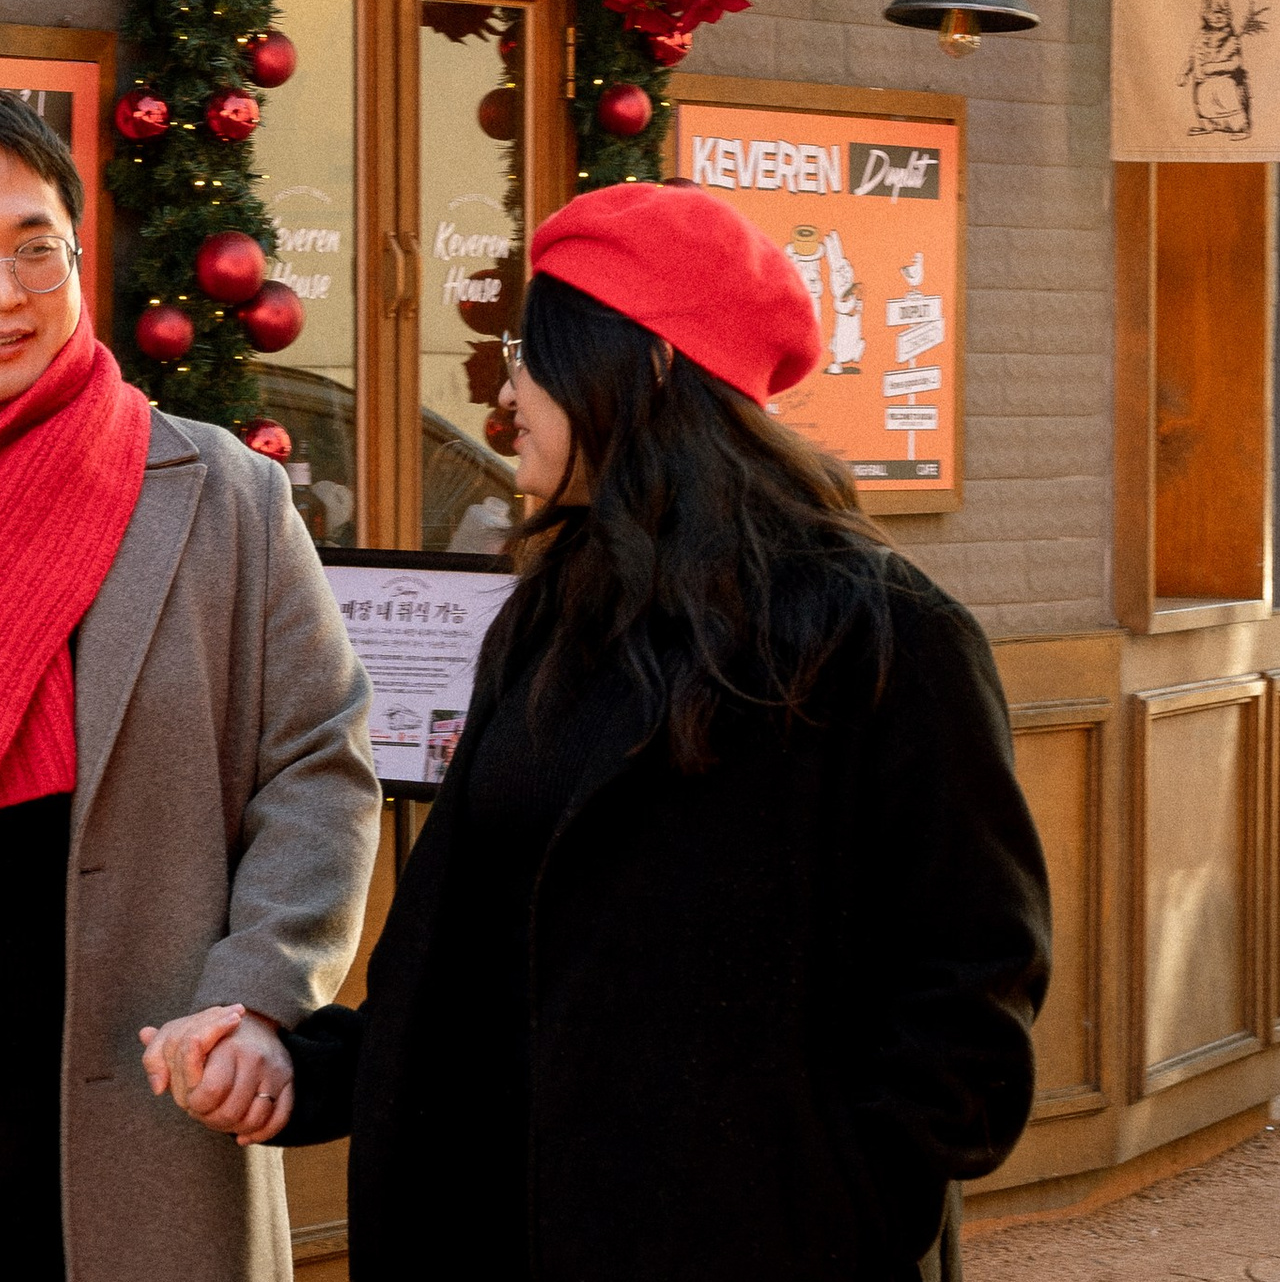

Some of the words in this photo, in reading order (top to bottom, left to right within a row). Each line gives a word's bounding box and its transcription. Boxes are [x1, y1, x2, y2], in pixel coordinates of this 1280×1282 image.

[692, 135, 842, 196] KEVEREN
[433, 221, 510, 261] Keveren
[441, 265, 502, 306] House
[377, 600, 394, 622] 내
[434, 603, 469, 625] 가능
